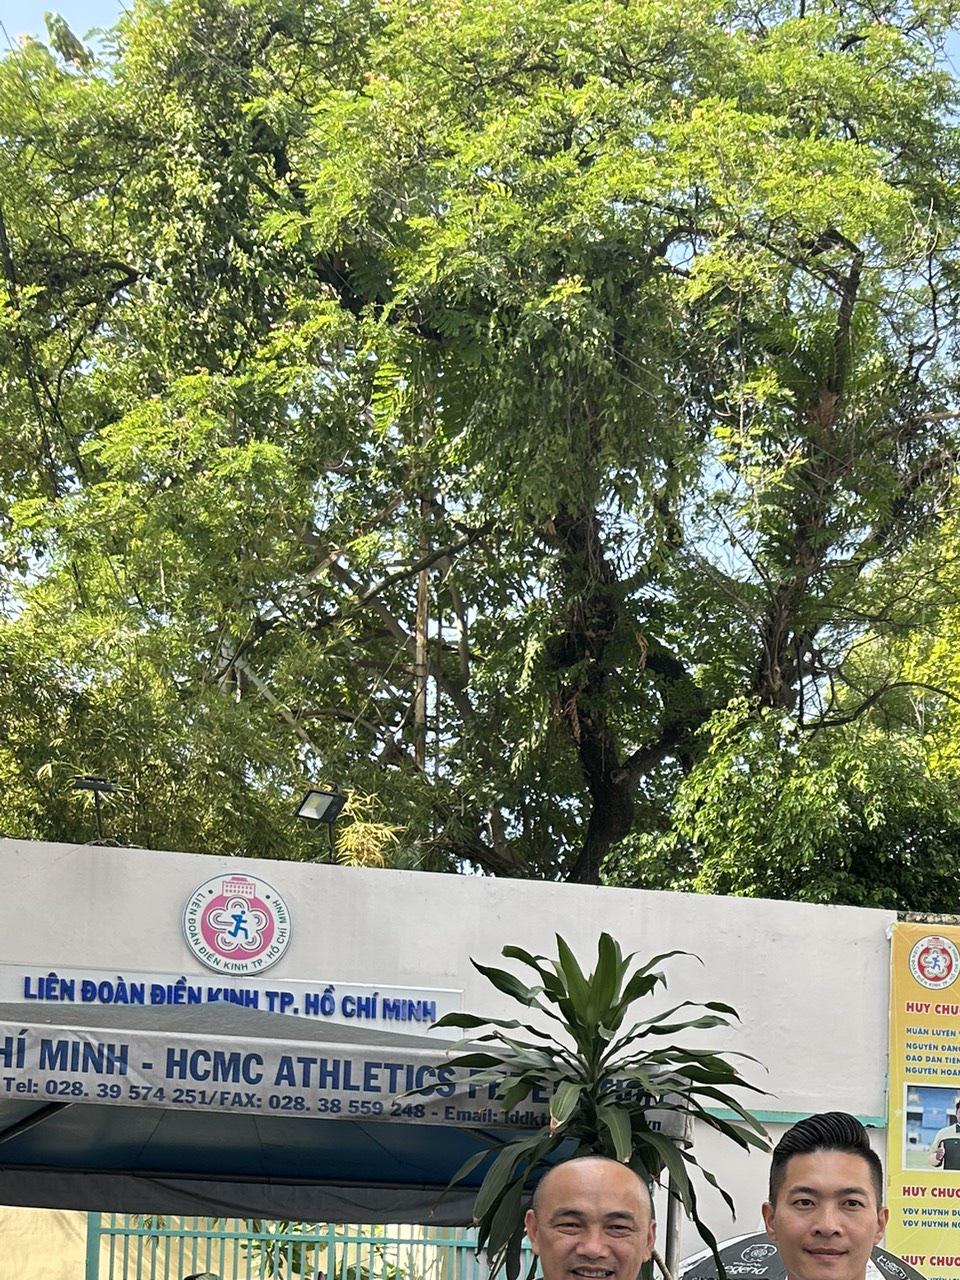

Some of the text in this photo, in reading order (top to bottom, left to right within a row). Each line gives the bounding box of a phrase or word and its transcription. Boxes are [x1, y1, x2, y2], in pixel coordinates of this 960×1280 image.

[223, 962, 249, 971] KINH
[272, 900, 288, 924] MINH
[24, 972, 437, 1022] LIÊN ĐOÀN ĐIỀN KINH TP. HỒ CHÍ MINH
[906, 1002, 931, 1014] HUY
[39, 1038, 129, 1076] MINH
[165, 1047, 264, 1085] HCMC
[274, 1055, 456, 1098] ATHLETICS
[3, 1077, 39, 1094] Tel:
[45, 1080, 89, 1097] 028.
[96, 1083, 122, 1099] 39
[128, 1085, 166, 1101] 574
[269, 1095, 310, 1111] 028.
[317, 1098, 342, 1113] 38
[348, 1101, 384, 1115] 559
[390, 1102, 425, 1118] 248
[444, 1105, 498, 1123] Email:
[902, 1186, 927, 1197] HUY
[716, 1262, 768, 1275] egend
